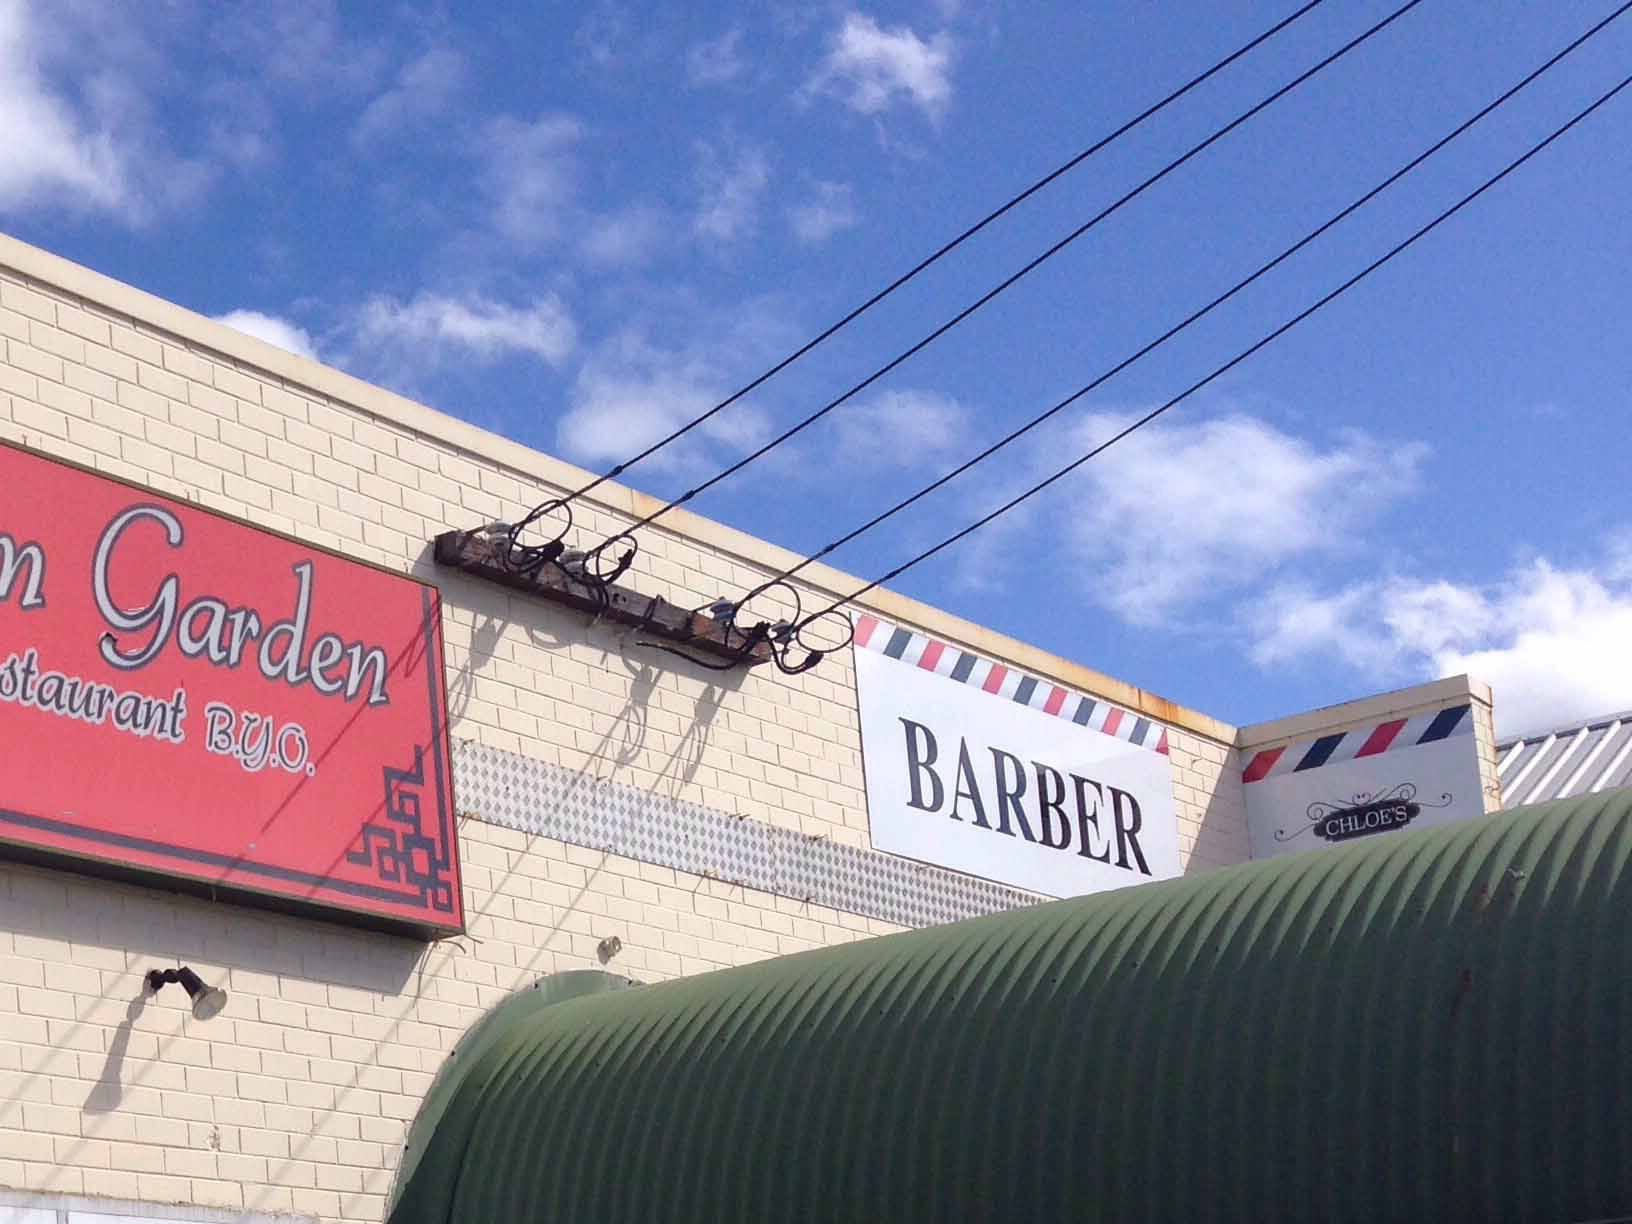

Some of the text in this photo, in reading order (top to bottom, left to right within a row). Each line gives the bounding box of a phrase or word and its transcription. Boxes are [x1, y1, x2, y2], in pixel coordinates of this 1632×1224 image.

[92, 502, 390, 708] Garden
[898, 716, 1153, 876] BARBER
[1326, 805, 1408, 836] CHLOE'S
